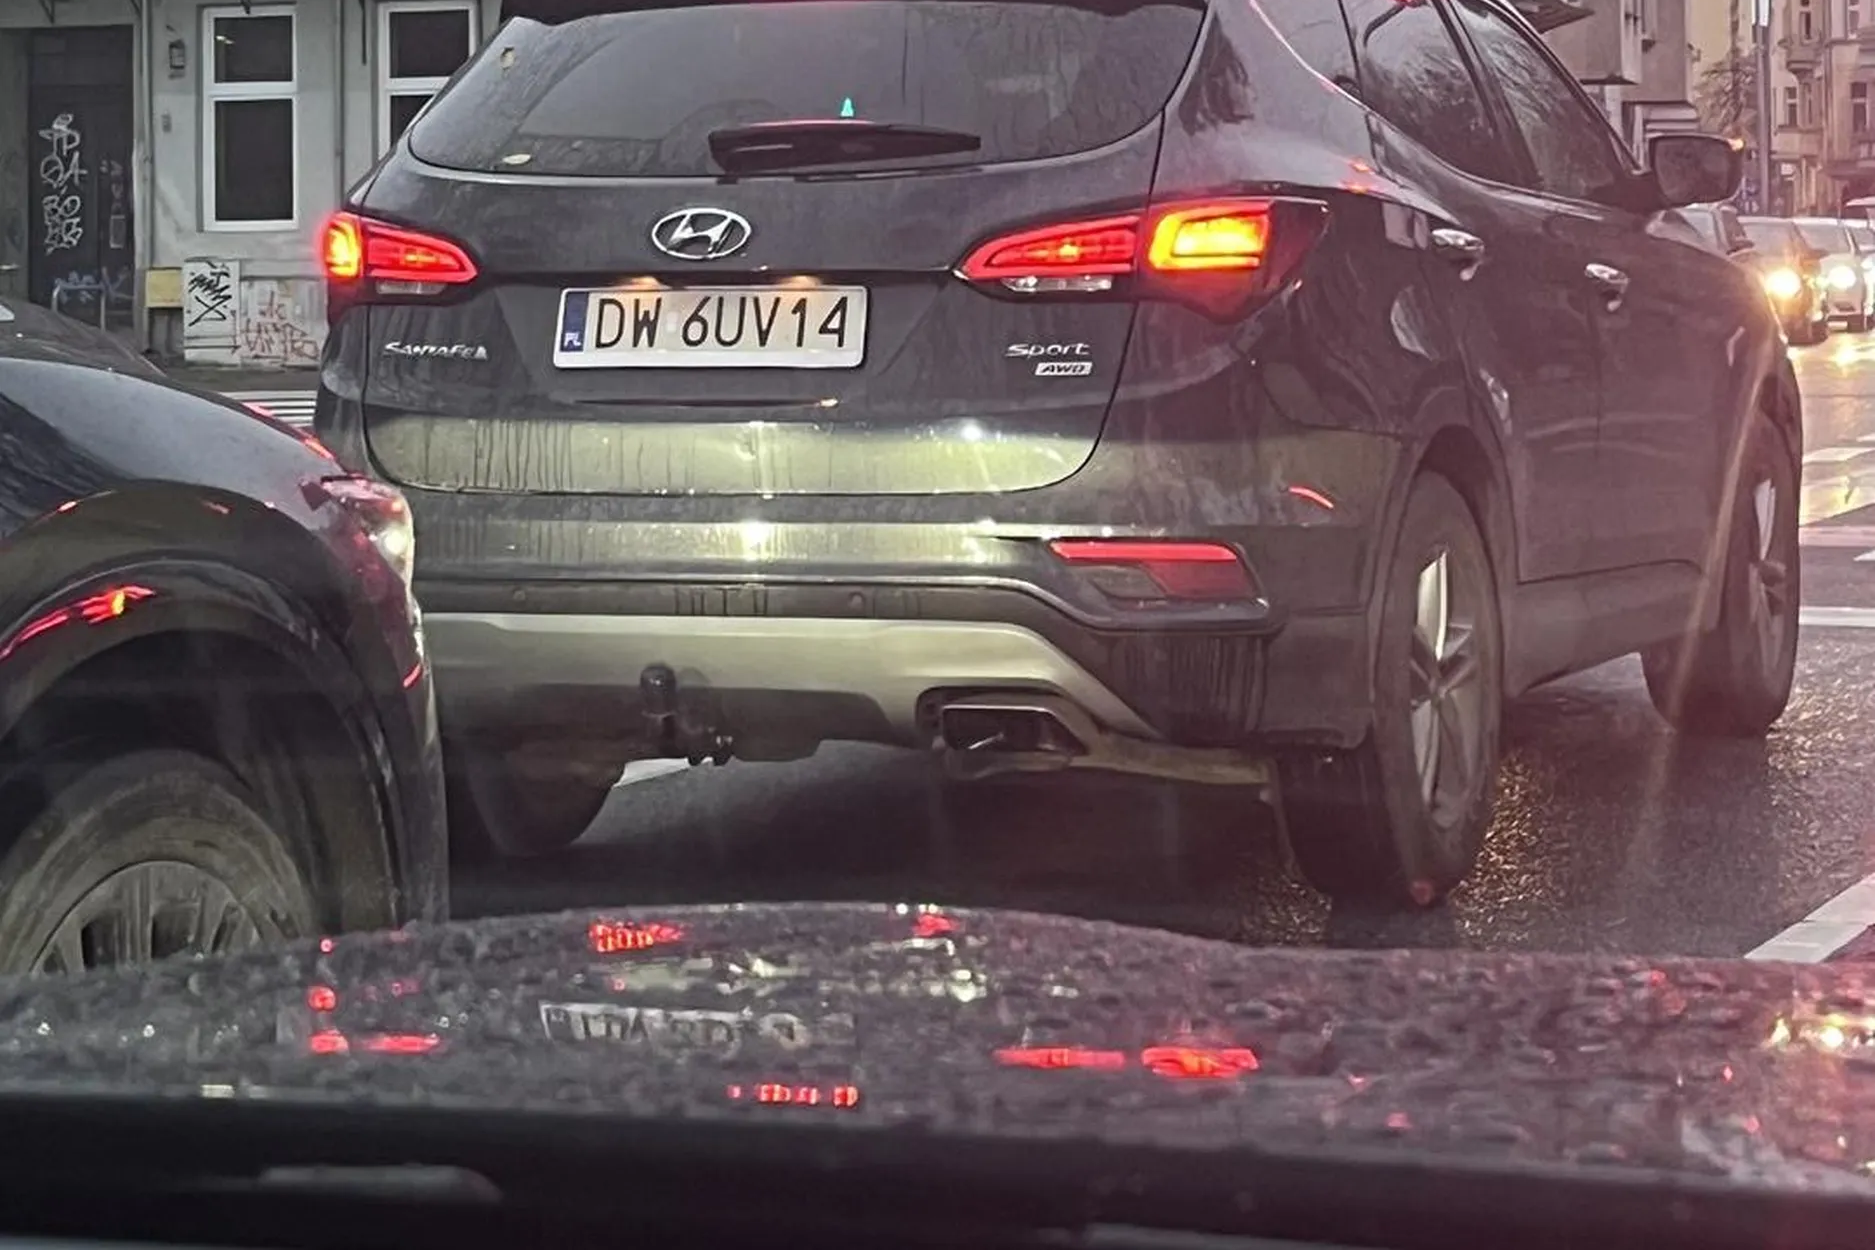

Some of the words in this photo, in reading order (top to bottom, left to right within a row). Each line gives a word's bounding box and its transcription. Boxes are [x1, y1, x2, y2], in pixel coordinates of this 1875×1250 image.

[595, 297, 662, 349] DW
[681, 295, 850, 348] 6UV14
[1004, 342, 1091, 359] Sport
[1041, 364, 1086, 373] AWD
